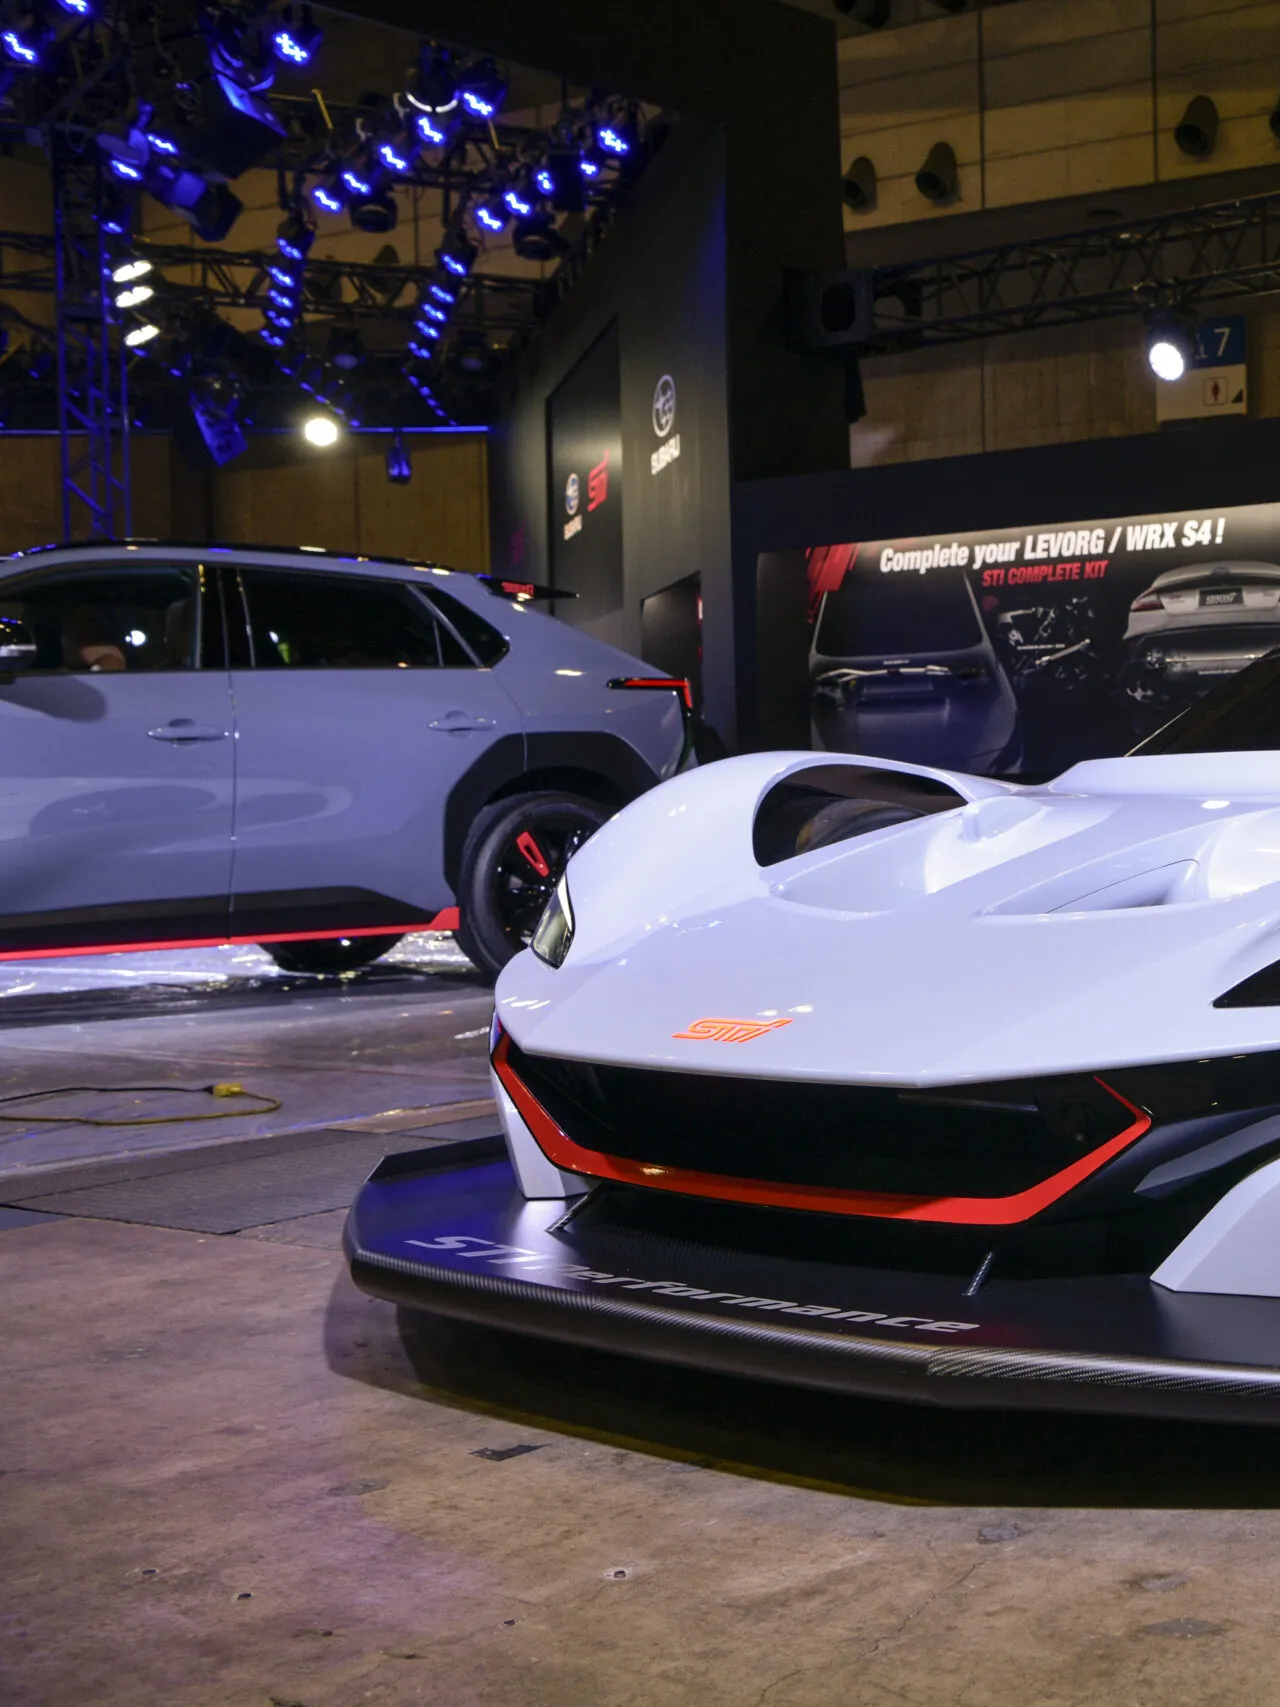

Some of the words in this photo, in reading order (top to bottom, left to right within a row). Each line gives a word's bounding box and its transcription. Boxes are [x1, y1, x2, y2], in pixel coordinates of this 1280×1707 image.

[1213, 326, 1231, 357] 7
[880, 541, 969, 574] Complete
[972, 542, 1020, 569] your
[1024, 526, 1105, 559] LEVORG
[1126, 522, 1179, 551] WRX
[982, 565, 1006, 588] STI
[1007, 561, 1081, 585] COMPLETE
[1083, 559, 1109, 581] KIT
[522, 1263, 981, 1333] Performance
